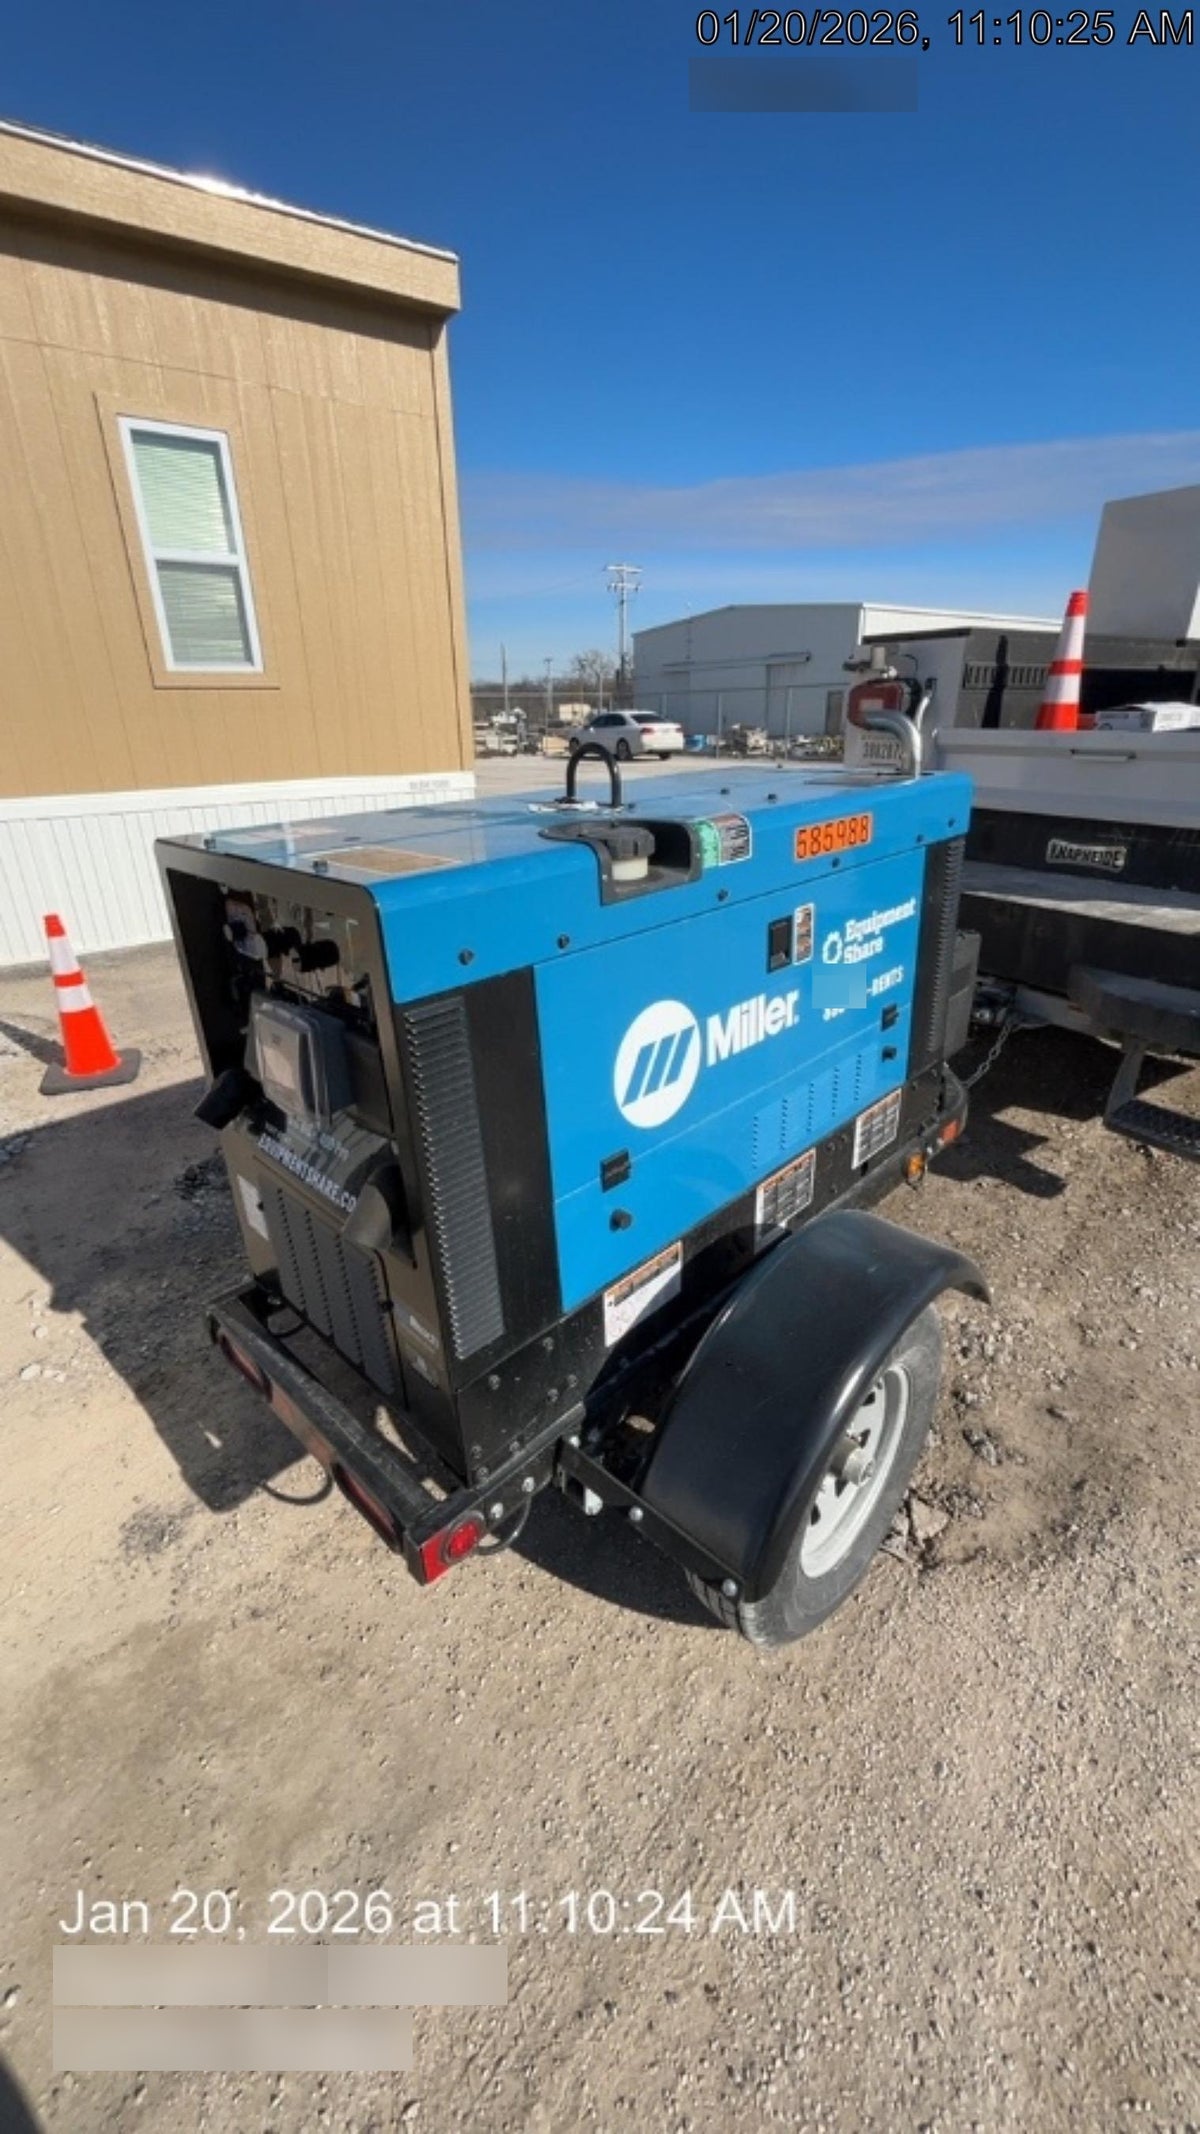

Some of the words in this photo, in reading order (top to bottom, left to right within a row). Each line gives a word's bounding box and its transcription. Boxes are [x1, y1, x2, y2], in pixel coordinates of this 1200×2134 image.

[797, 814, 869, 859] 585988
[845, 896, 916, 942] Equipment
[843, 936, 883, 964] Share
